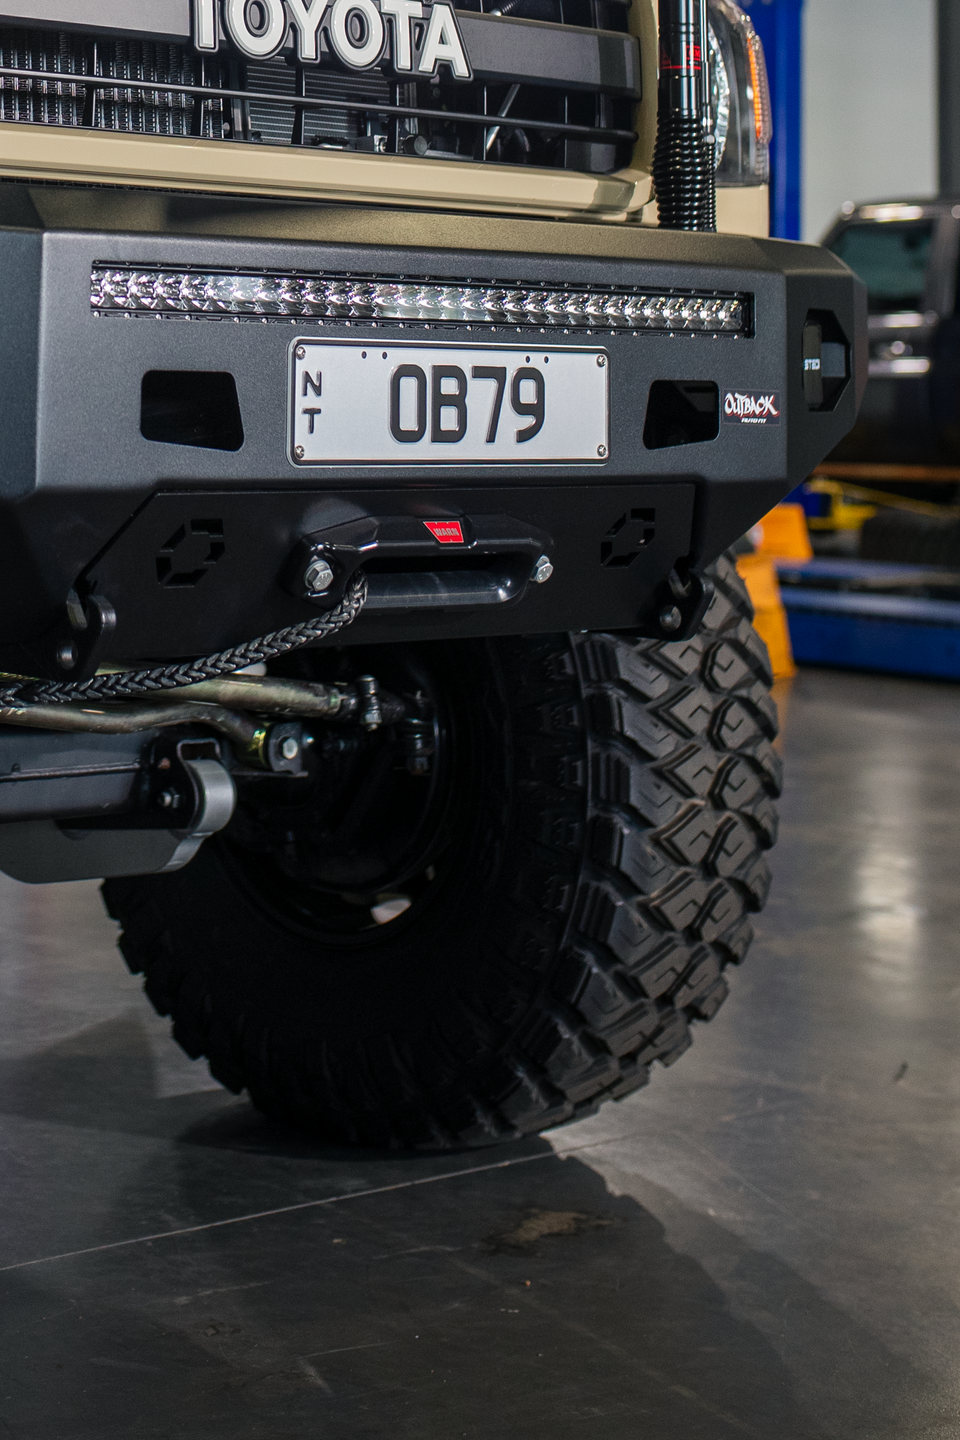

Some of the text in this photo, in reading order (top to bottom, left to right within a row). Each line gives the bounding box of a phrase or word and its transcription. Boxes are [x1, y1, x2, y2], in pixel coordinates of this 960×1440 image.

[803, 358, 821, 371] STED
[724, 392, 779, 417] OUTBACK
[433, 528, 460, 536] WARN
